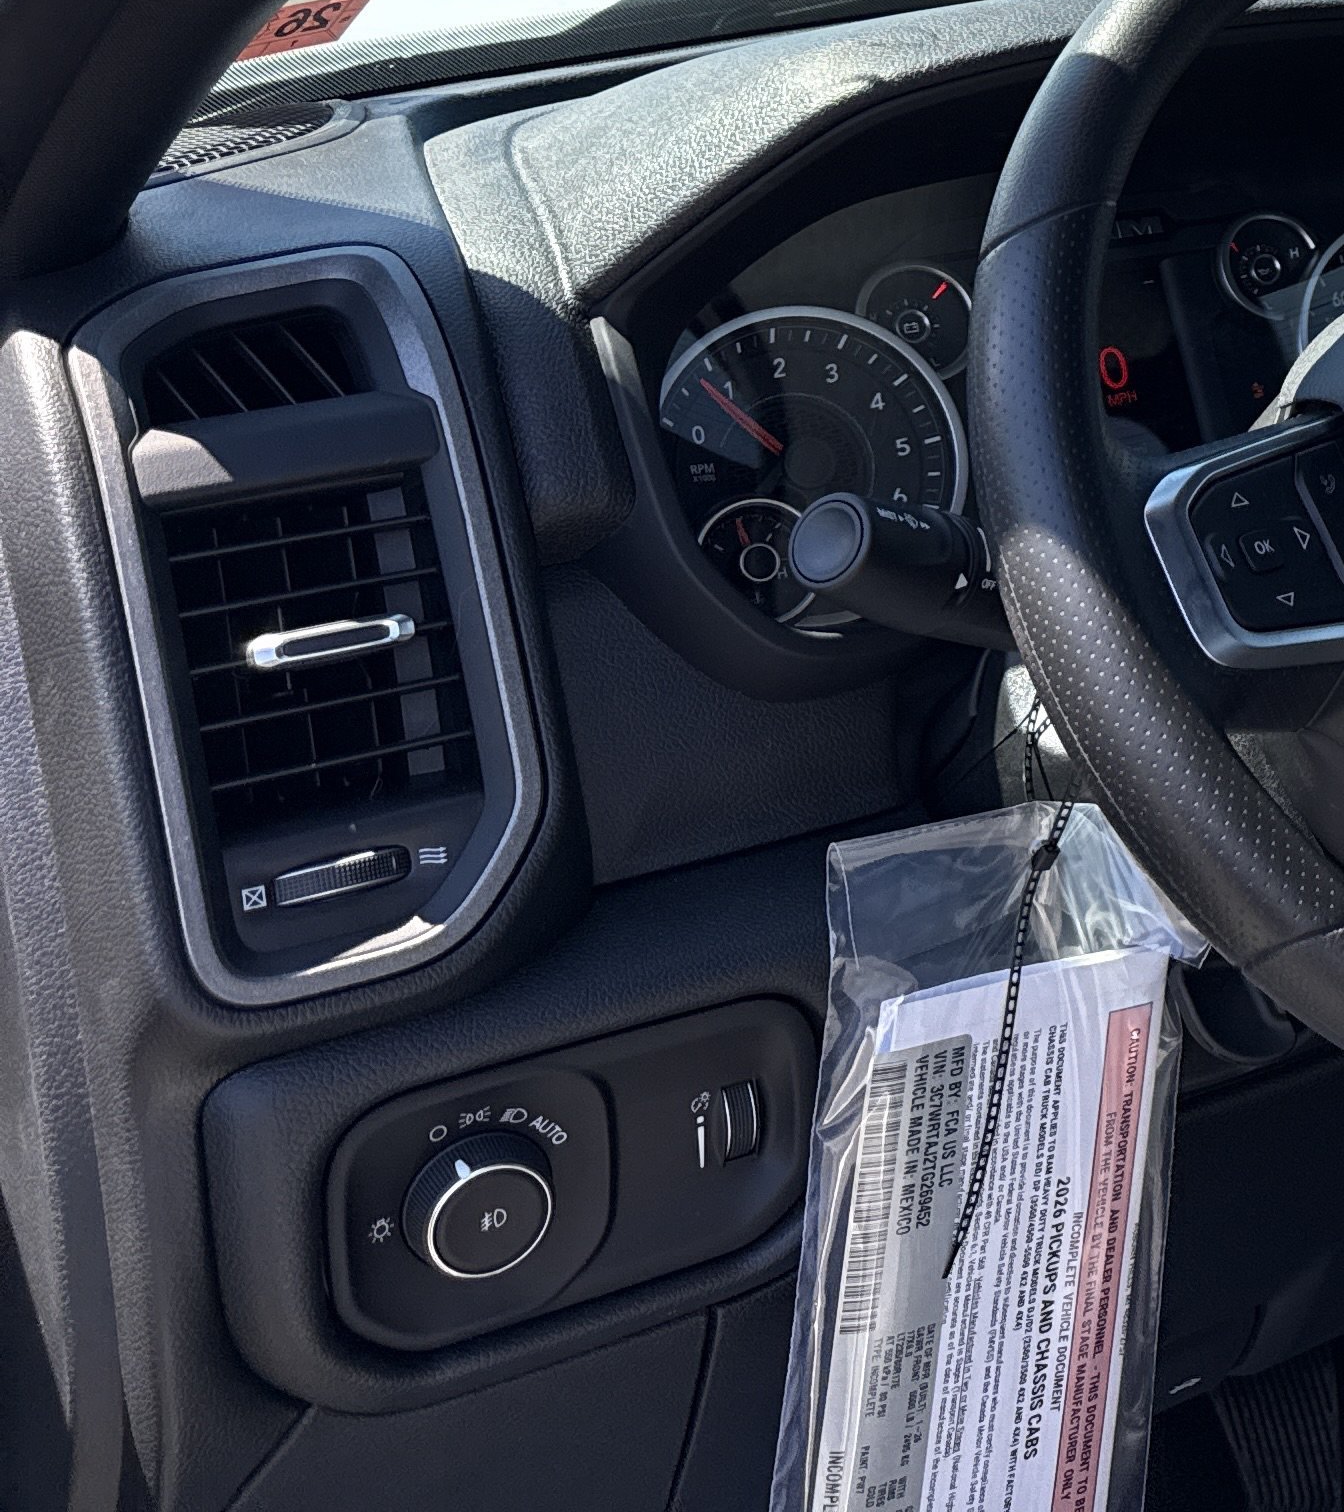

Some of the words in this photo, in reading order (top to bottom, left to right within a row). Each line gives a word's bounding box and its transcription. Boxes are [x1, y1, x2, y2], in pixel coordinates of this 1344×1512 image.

[772, 357, 787, 379] 2
[825, 363, 840, 384] 3
[870, 392, 886, 411] 4
[1106, 391, 1138, 407] MPH
[691, 426, 706, 445] 0
[896, 438, 911, 456] 5
[690, 463, 716, 476] RPM
[1254, 539, 1275, 555] OK
[1045, 1024, 1057, 1065] CHASSIS
[1057, 1021, 1068, 1044] THIS
[931, 1049, 947, 1078] VIN:
[949, 1045, 964, 1077] MFD
[1124, 1027, 1140, 1087] CAUTION:
[909, 1054, 929, 1112] VEHICLE
[1043, 1067, 1052, 1086] CAB
[1052, 1046, 1066, 1096] DOCUMENT
[947, 1080, 961, 1103] BY:
[1039, 1088, 1050, 1120] TRUCK
[529, 1115, 567, 1145] AUTO
[943, 1109, 959, 1136] FCA
[1048, 1099, 1060, 1137] APPLIED
[1102, 1111, 1116, 1147] FROM
[904, 1116, 922, 1155] MADE
[1035, 1122, 1046, 1159] MODELS
[1046, 1139, 1055, 1151] TO
[1111, 1090, 1133, 1201] TRANSPORTATION
[914, 1084, 945, 1229] 3C7WRTAJ2TG269452
[941, 1139, 956, 1160] US
[1099, 1149, 1112, 1174] THE
[902, 1159, 917, 1179] IN:
[938, 1162, 954, 1187] LLC
[1043, 1153, 1054, 1175] RAM
[1040, 1176, 1051, 1206] HEAVY
[1052, 1176, 1070, 1219] 2026
[1092, 1177, 1108, 1230] VEHICLE
[895, 1183, 915, 1236] MEXICO
[1037, 1208, 1047, 1232] DUTY
[1107, 1208, 1119, 1233] AND
[1032, 1234, 1044, 1265] TRUCK
[1064, 1211, 1083, 1287] INCOMPLETE
[1090, 1232, 1102, 1251] BY
[1042, 1222, 1064, 1295] PICKUPS
[1087, 1253, 1099, 1277] THE
[1101, 1237, 1116, 1284] DEALER
[1019, 1270, 1028, 1287] 4X2
[1028, 1267, 1040, 1304] MODELS
[1016, 1289, 1025, 1307] AND
[1082, 1280, 1096, 1316] FINAL
[1012, 1309, 1023, 1330] 4X4)
[1037, 1297, 1054, 1334] AND
[1057, 1292, 1073, 1343] VEHICLE
[1092, 1287, 1110, 1359] PERSONNEL
[884, 1335, 894, 1346] AT
[924, 1323, 935, 1346] DATE
[1077, 1319, 1092, 1360] STAGE
[882, 1349, 892, 1364] 550
[923, 1347, 932, 1358] OF
[881, 1365, 890, 1381] kPa
[1029, 1337, 1050, 1411] CHASSIS
[1049, 1345, 1067, 1413] DOCUMENT
[864, 1365, 879, 1418] INCOMPLETE
[1016, 1386, 1025, 1403] 4X2
[1086, 1372, 1100, 1402] THIS
[876, 1404, 885, 1418] PSI
[1013, 1405, 1023, 1424] AND
[1064, 1363, 1086, 1464] MANUFACTURER
[1009, 1426, 1020, 1447] 4X4)
[1022, 1413, 1041, 1461] CABS
[1078, 1403, 1096, 1472] DOCUMENT
[1007, 1448, 1017, 1472] WITH
[865, 1485, 875, 1508] COLD
[875, 1482, 887, 1507] TIRES
[886, 1479, 897, 1500] RIMS
[896, 1475, 907, 1499] WITH
[1060, 1468, 1074, 1501] ONLY
[1076, 1478, 1087, 1494] TO
